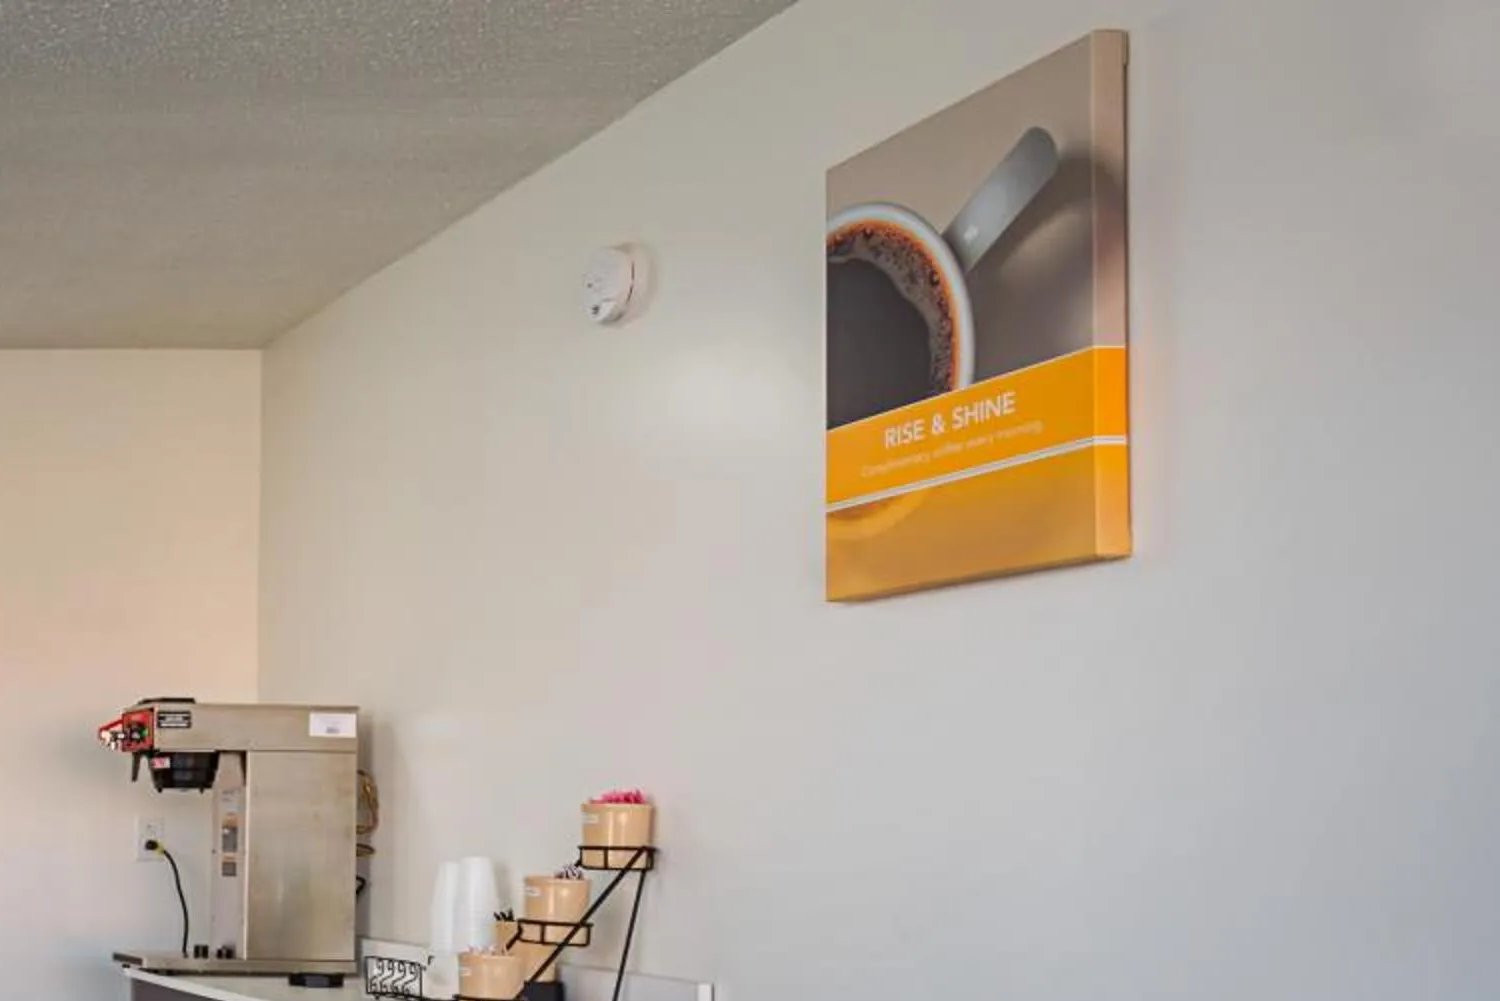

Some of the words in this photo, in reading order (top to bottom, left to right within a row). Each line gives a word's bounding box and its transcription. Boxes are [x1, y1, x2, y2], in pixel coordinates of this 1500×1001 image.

[885, 418, 925, 448] RISE
[931, 413, 945, 435] &
[952, 391, 1016, 430] SHINE
